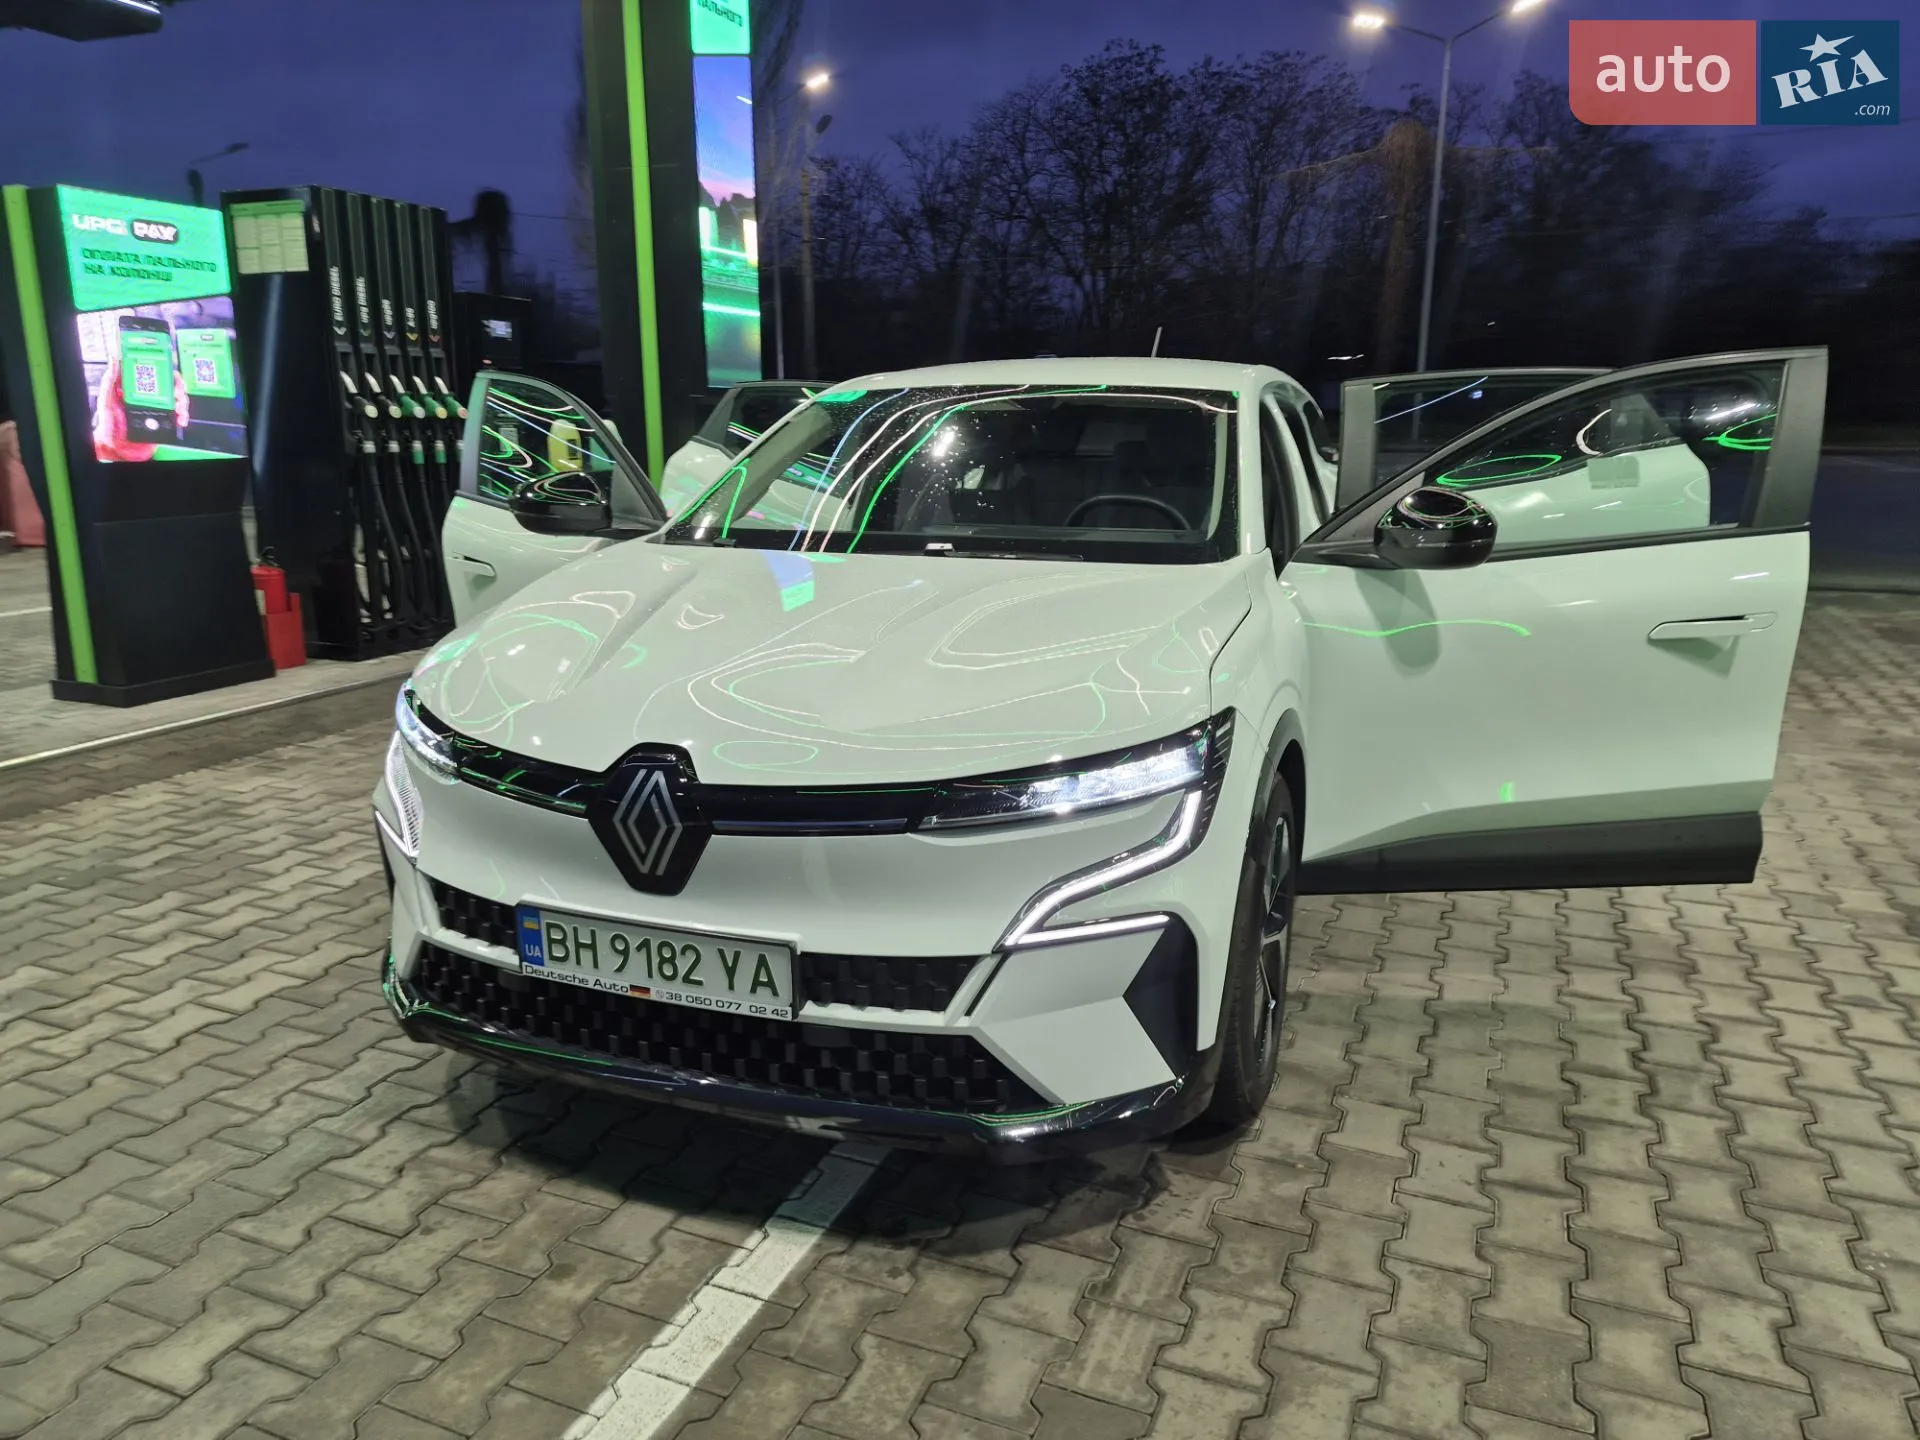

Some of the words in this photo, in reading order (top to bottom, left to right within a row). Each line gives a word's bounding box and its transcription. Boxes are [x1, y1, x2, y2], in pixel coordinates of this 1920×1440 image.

[72, 213, 128, 236] UPG
[133, 220, 178, 241] PAY
[329, 266, 342, 296] DIESEL
[355, 276, 367, 306] DIESEL
[525, 943, 542, 958] UA
[545, 921, 599, 969] BH
[609, 932, 705, 986] 9182
[717, 947, 780, 997] YA
[524, 965, 590, 986] Deutsche
[593, 978, 630, 994] Auto
[685, 994, 713, 1007] 050
[715, 999, 743, 1011] 077
[749, 1004, 768, 1015] 02
[771, 1008, 789, 1018] 42
